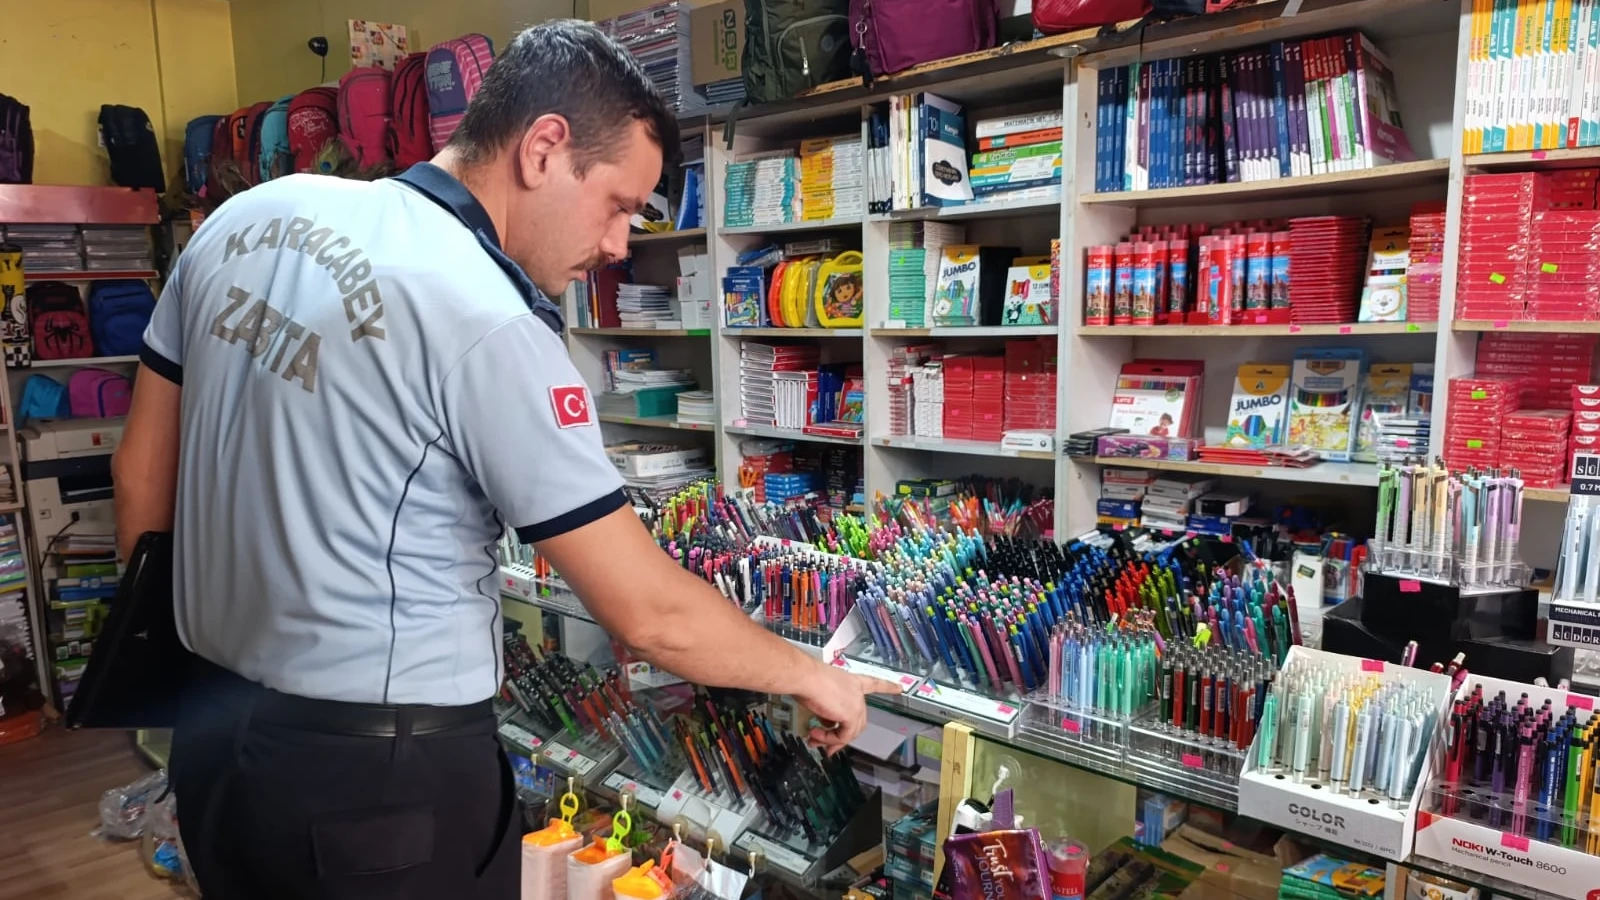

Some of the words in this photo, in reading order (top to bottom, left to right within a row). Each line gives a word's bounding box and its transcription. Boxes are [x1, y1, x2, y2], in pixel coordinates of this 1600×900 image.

[222, 216, 386, 342] KARACABEY
[942, 261, 976, 278] JUMBO
[1235, 394, 1282, 412] JUMBO
[1580, 483, 1594, 491] 0.7
[1555, 607, 1597, 618] MECHANICAL
[1288, 802, 1346, 829] COLOR
[983, 838, 1014, 882] Trust
[1451, 846, 1489, 862] Mechanical
[1489, 857, 1512, 868] pencil
[1452, 838, 1484, 853] NOKI
[1485, 847, 1534, 867] W-Touch
[1535, 860, 1568, 876] 8600
